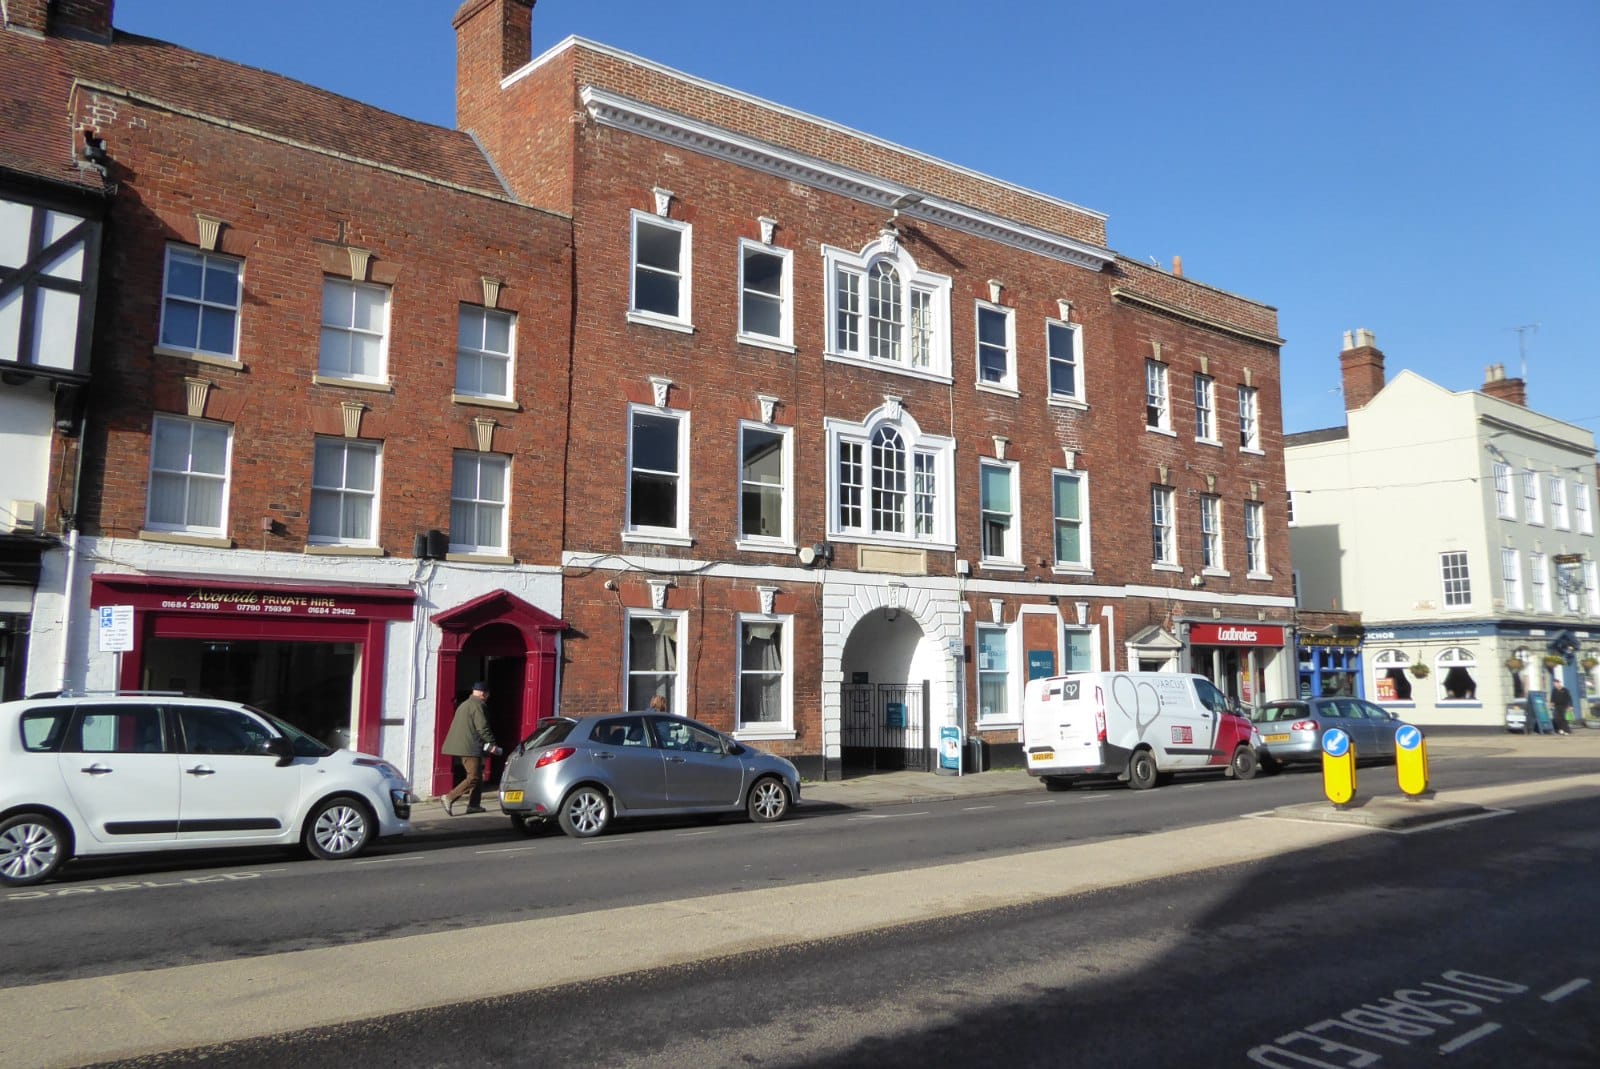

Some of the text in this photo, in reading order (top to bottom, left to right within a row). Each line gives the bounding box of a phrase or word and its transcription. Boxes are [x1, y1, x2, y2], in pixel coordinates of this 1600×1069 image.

[162, 600, 187, 609] 01684
[186, 588, 335, 607] Avonside PRIVATE HIRE
[1218, 626, 1258, 642] Ladbrokes
